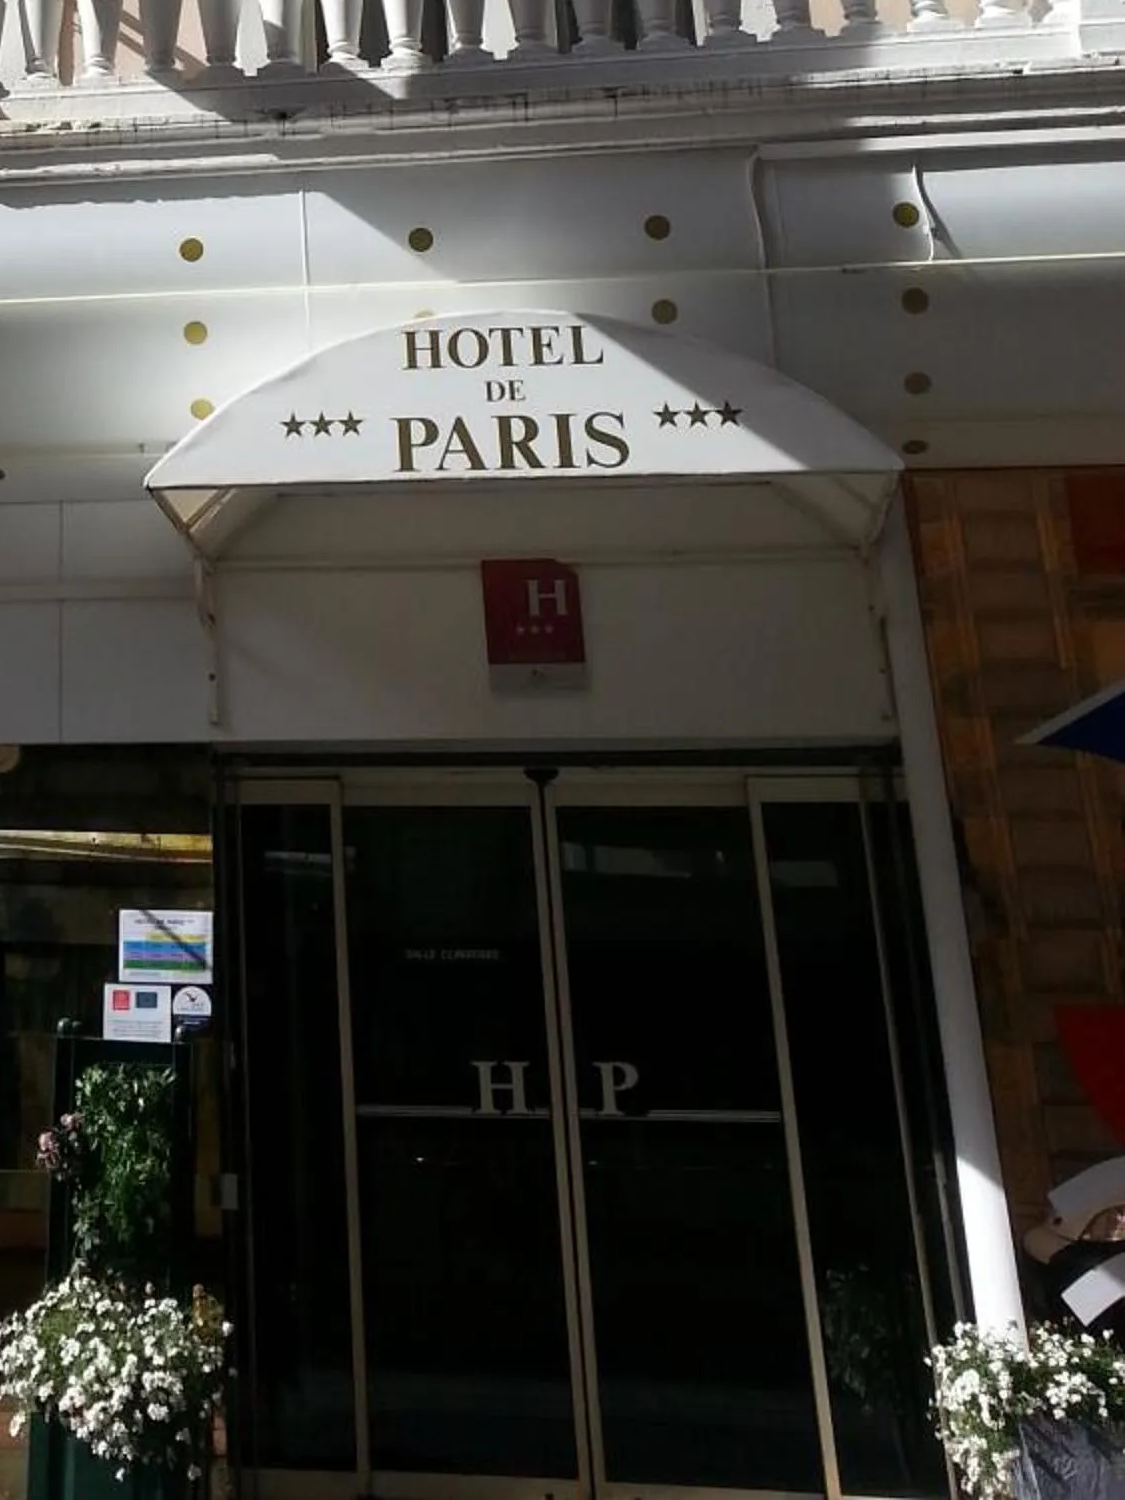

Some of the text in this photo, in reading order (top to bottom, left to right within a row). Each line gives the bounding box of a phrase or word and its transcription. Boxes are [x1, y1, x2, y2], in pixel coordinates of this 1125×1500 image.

[401, 325, 604, 370] HOTEL
[485, 379, 526, 402] DE
[389, 411, 630, 473] PARIS
[527, 578, 568, 616] H
[469, 1060, 640, 1116] H P
